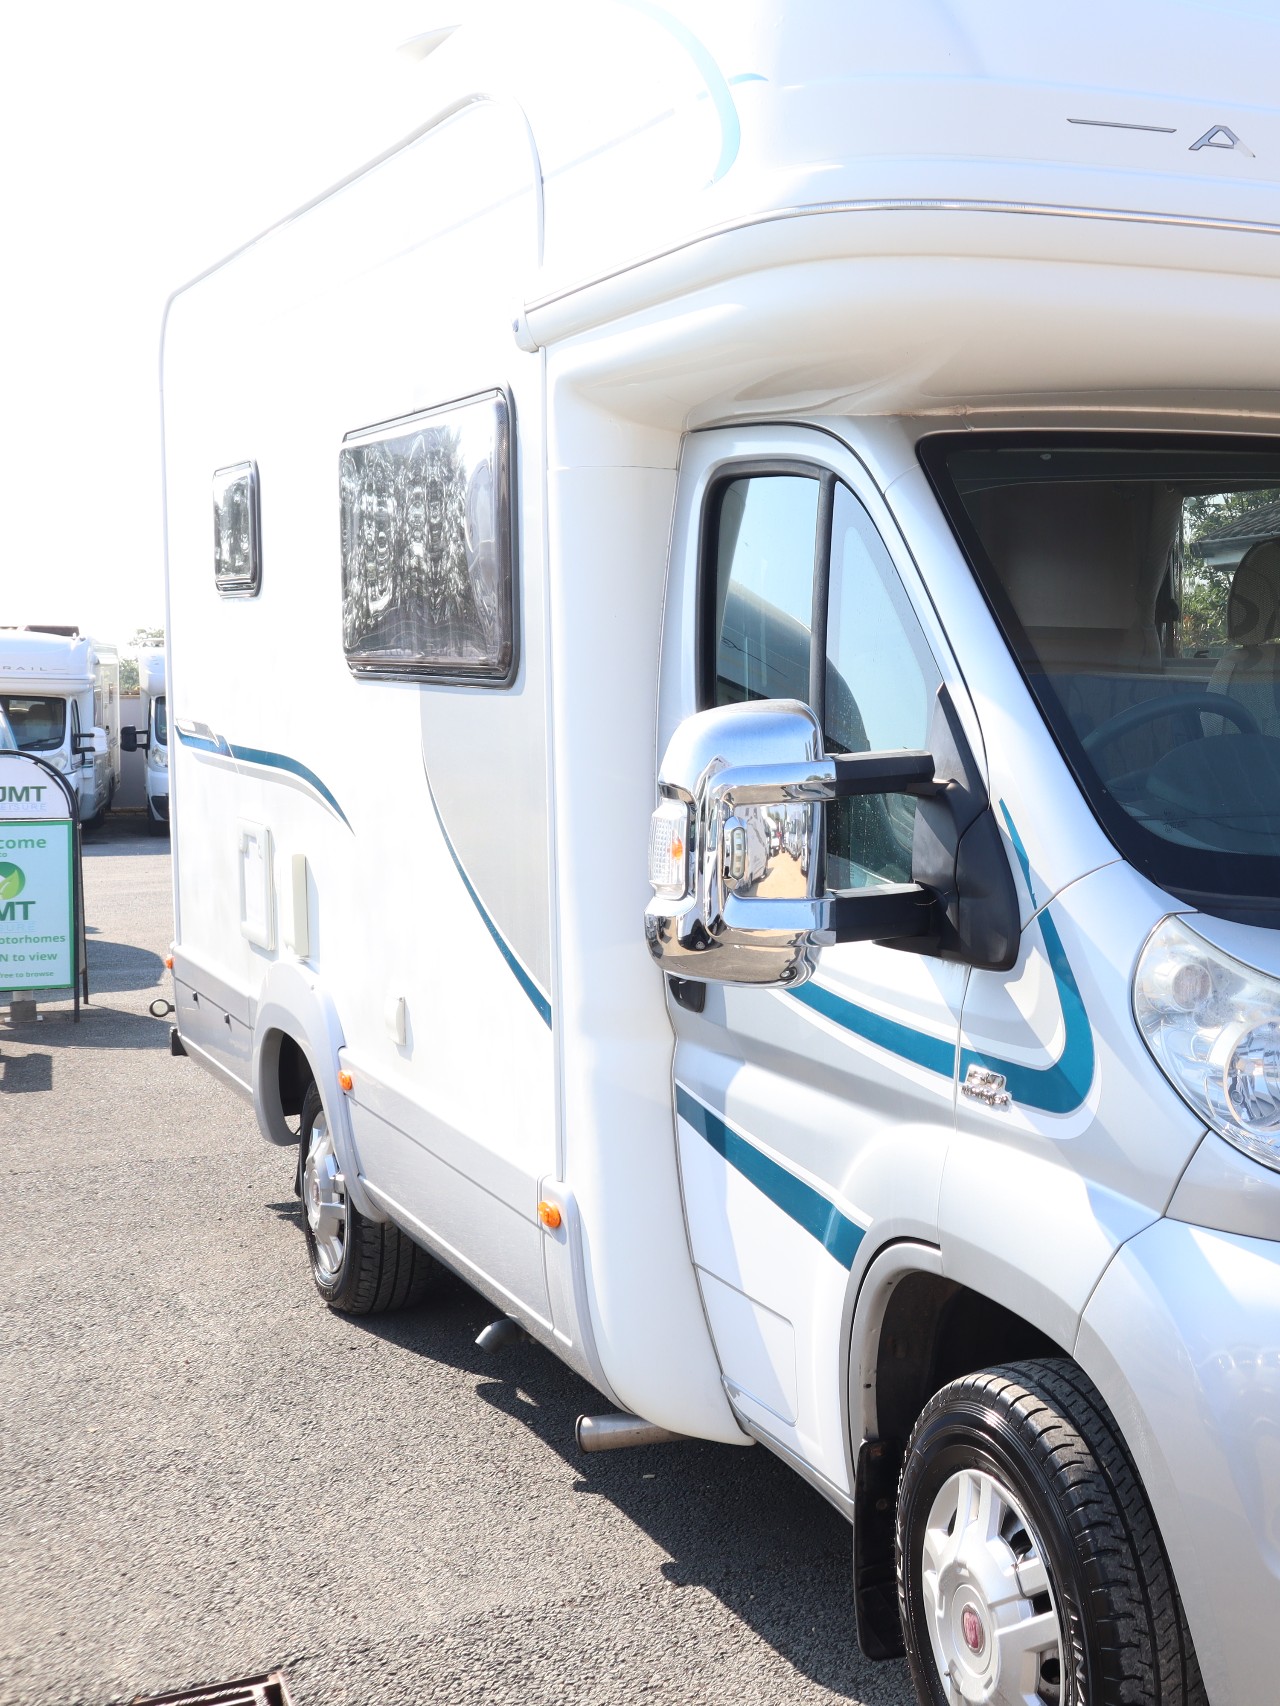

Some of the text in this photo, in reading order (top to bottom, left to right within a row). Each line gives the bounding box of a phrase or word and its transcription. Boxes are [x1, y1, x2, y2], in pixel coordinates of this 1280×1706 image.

[0, 786, 47, 803] JMT
[12, 953, 25, 962] to
[29, 951, 58, 961] view
[25, 970, 54, 978] browse
